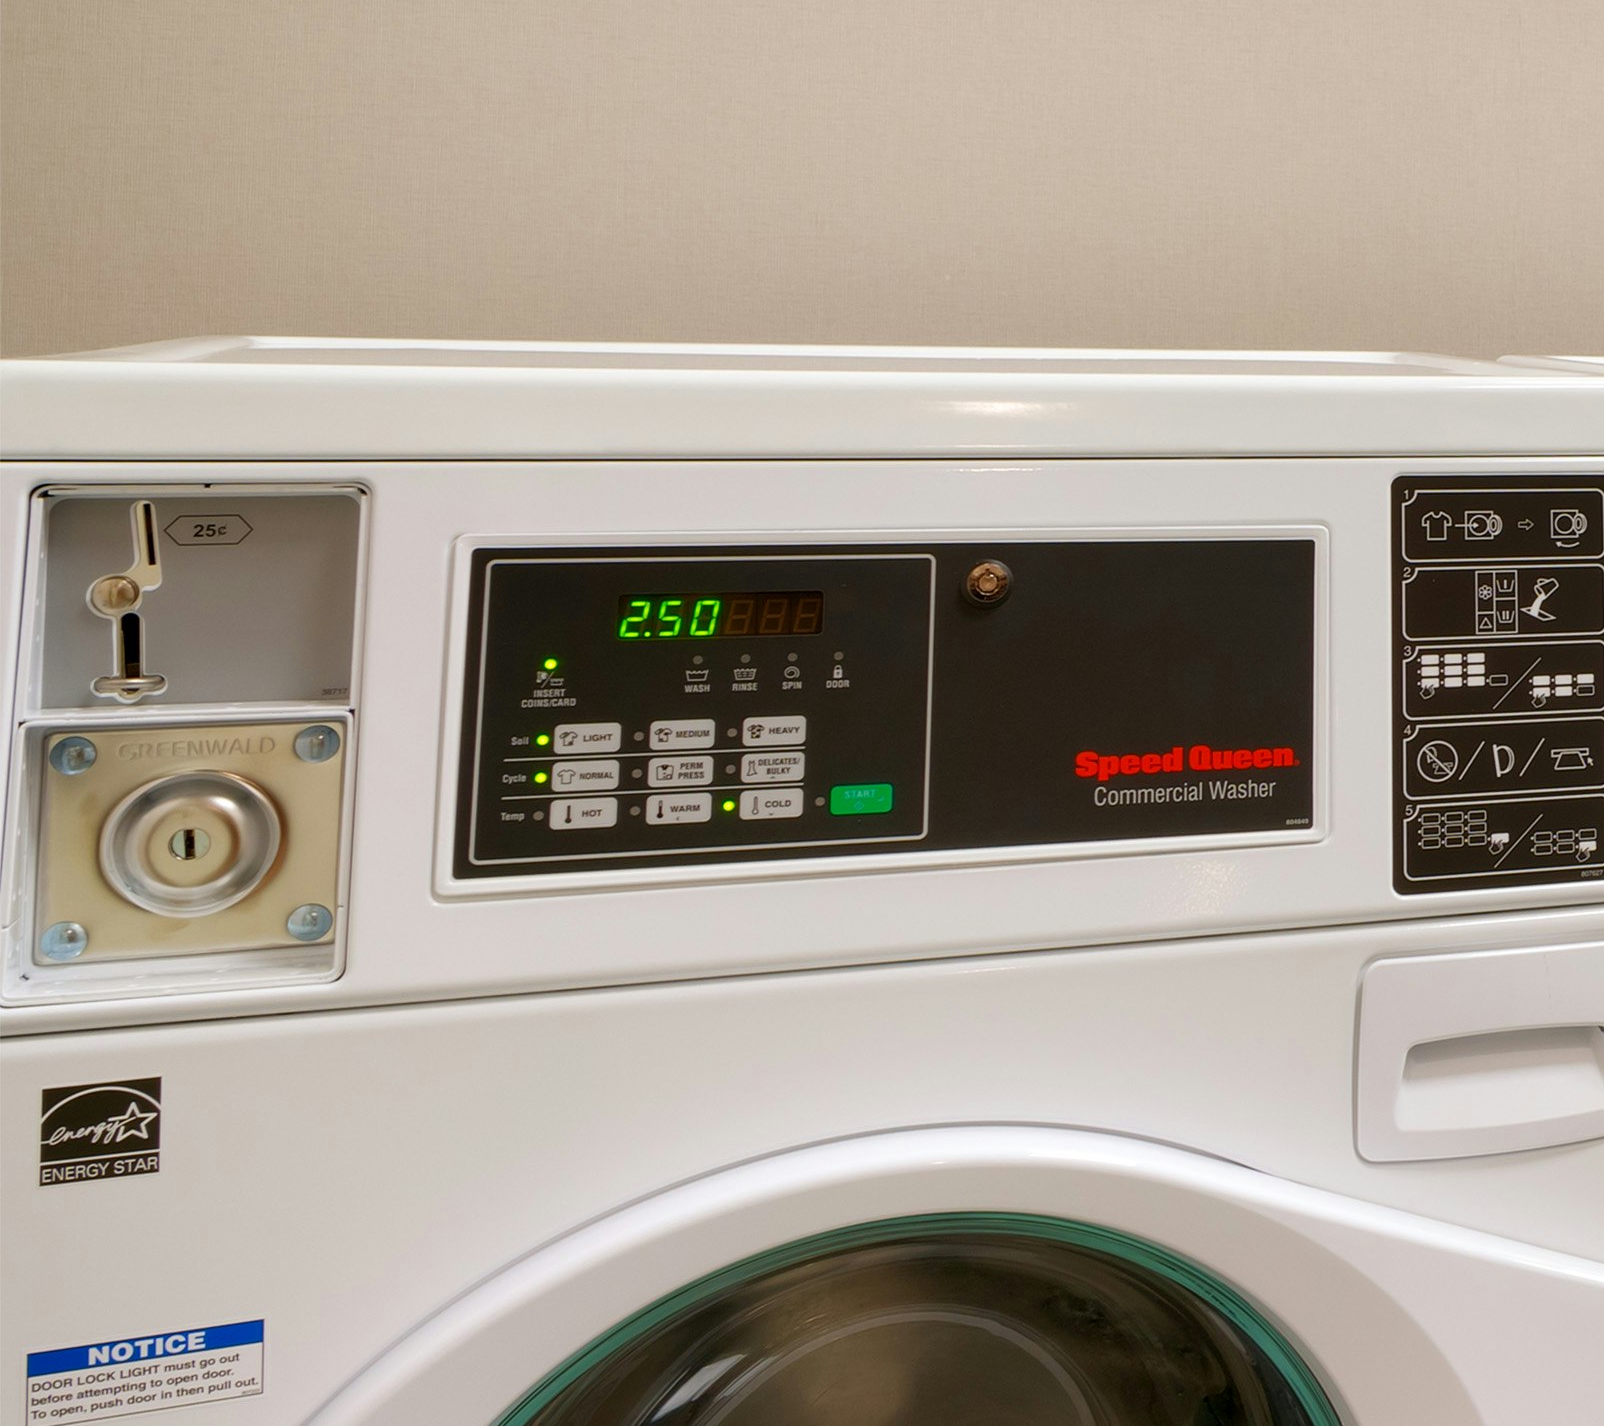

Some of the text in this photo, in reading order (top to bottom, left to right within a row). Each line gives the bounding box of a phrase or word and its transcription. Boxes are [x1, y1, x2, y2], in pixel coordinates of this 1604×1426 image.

[1403, 490, 1410, 500] 1
[1403, 568, 1411, 577] 2
[618, 598, 721, 638] 2.50
[1403, 646, 1412, 656] 3
[684, 684, 711, 693] WASH
[732, 683, 758, 692] RINSE
[782, 681, 802, 690] SPIN
[826, 680, 850, 689] DOOR
[533, 688, 566, 698] INSERT
[521, 698, 577, 708] COINS/CARD
[1404, 725, 1412, 735] 4
[511, 726, 800, 746] Soil LIGHT MEDIUM HEAVY
[119, 736, 276, 761] GREENWALD
[680, 762, 704, 770] PERM
[1074, 745, 1295, 781] Speed Queen
[502, 772, 614, 784] Cycle NORMAL
[678, 771, 705, 779] PRESS
[1094, 779, 1276, 807] Commercial Washer
[501, 790, 876, 822] Temp HOT WARM COLD START
[1405, 805, 1414, 815] 5
[42, 1156, 158, 1183] ENERGY STAR
[88, 1331, 206, 1366] NOTICE
[31, 1353, 240, 1393] DOOR LOCK LIGHT must go out
[31, 1367, 235, 1407] before attempting to open door.
[31, 1410, 47, 1420] To
[50, 1404, 87, 1419] open,
[90, 1398, 123, 1413] push
[127, 1393, 156, 1406] door
[161, 1390, 172, 1399] in
[176, 1384, 204, 1397] then
[208, 1380, 231, 1395] pull
[234, 1377, 259, 1388] out.
